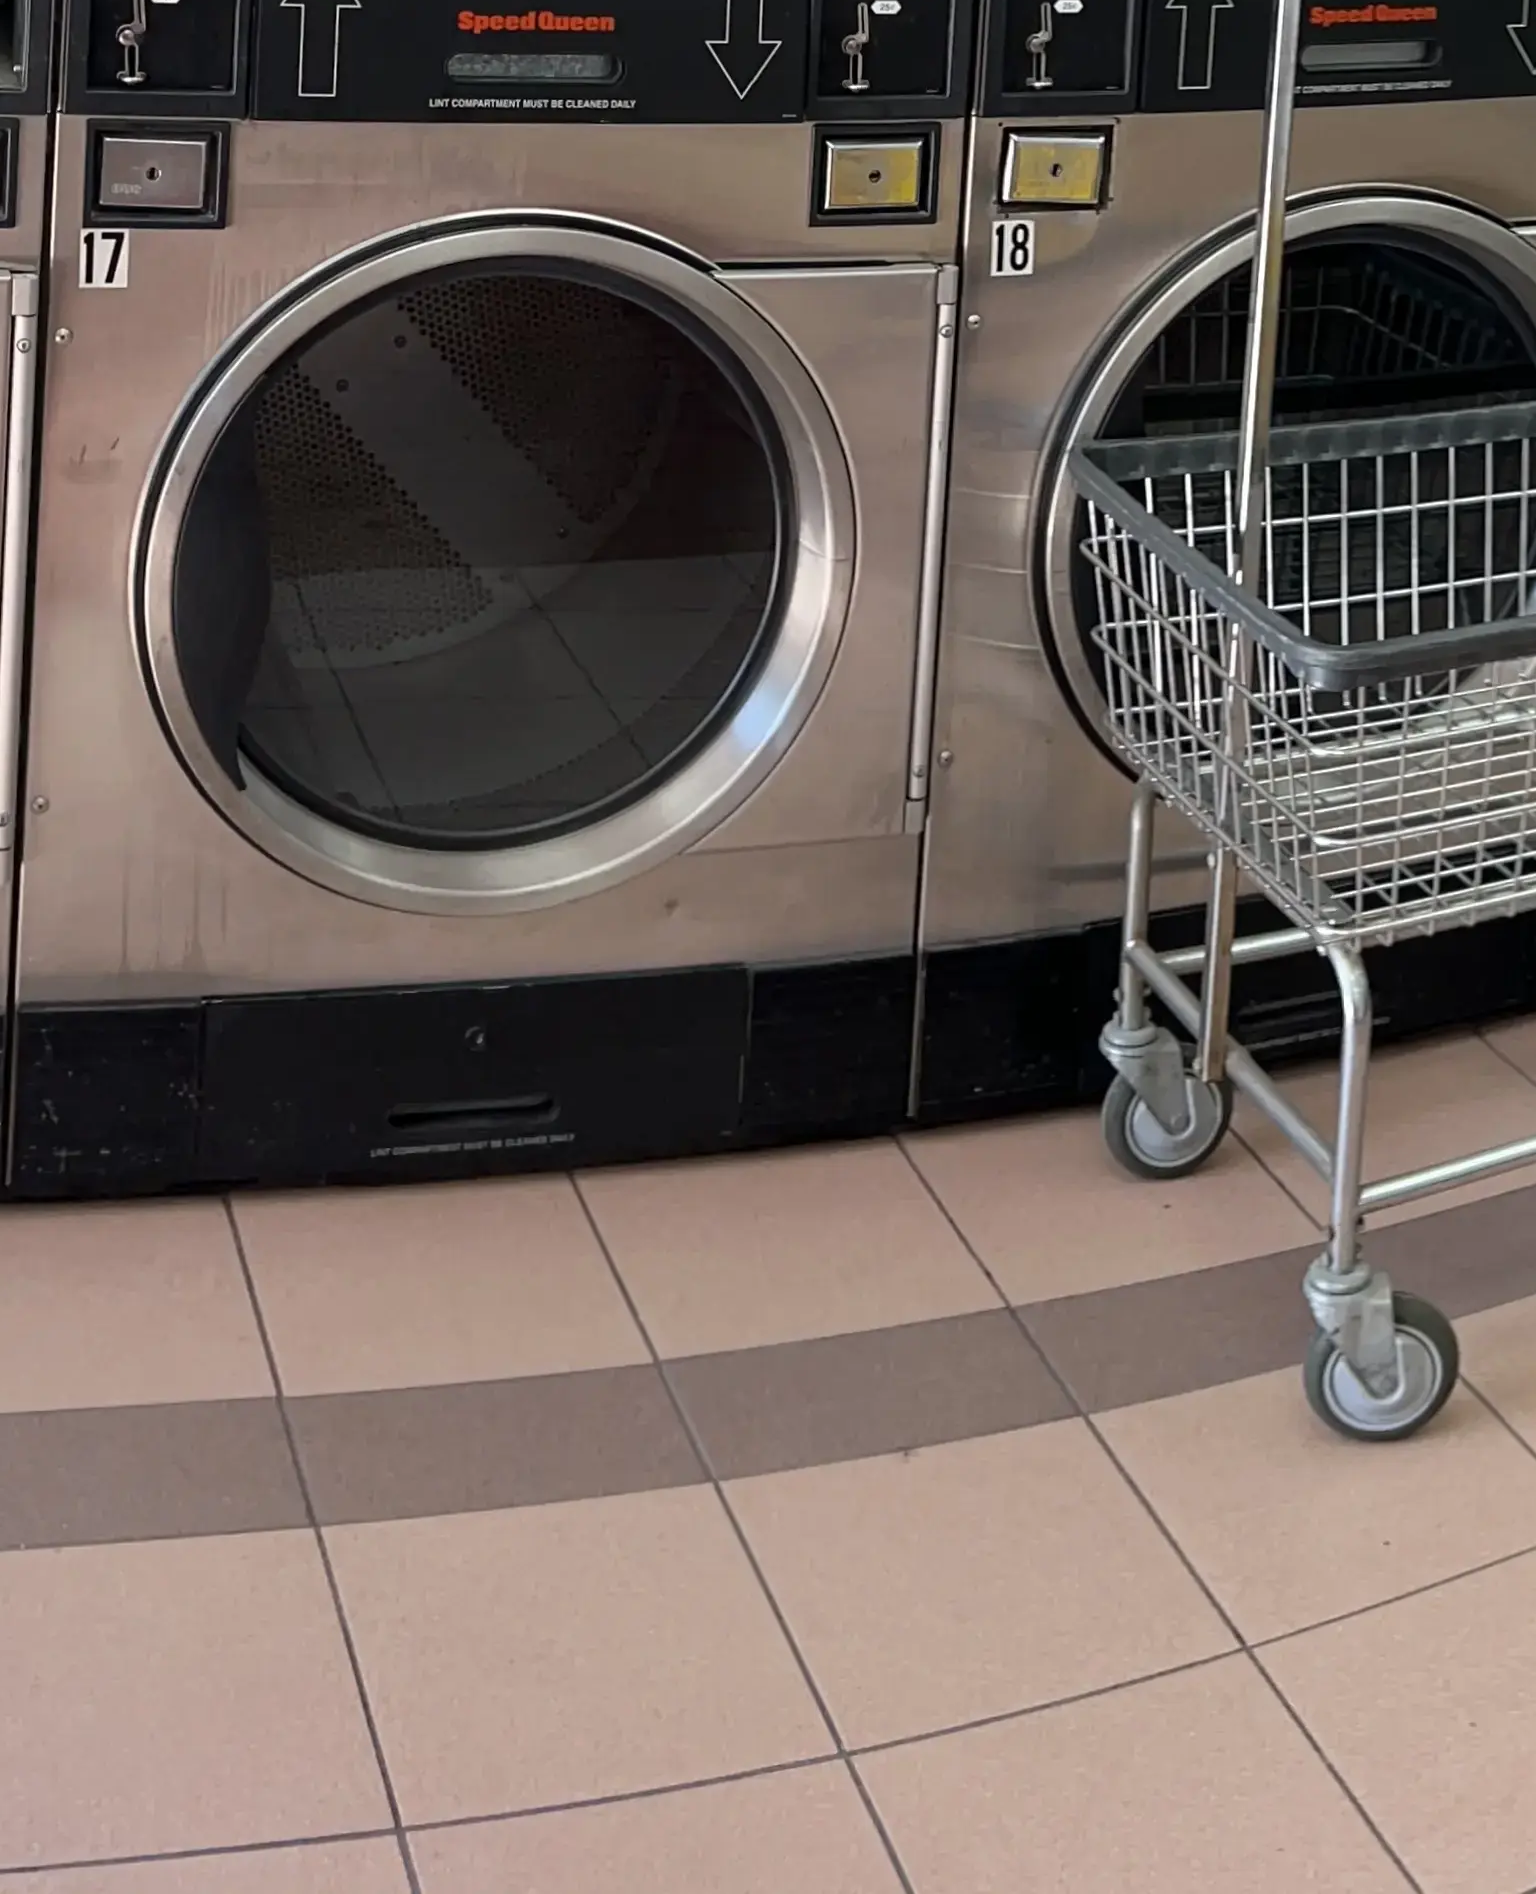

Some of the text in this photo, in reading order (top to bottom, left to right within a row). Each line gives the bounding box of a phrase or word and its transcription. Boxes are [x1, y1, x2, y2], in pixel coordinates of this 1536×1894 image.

[457, 9, 615, 35] Speed Queen
[428, 97, 637, 109] LINT COMPARTMENT MUST BE CLEANED DAILY
[83, 231, 126, 284] 17
[995, 222, 1030, 273] 18
